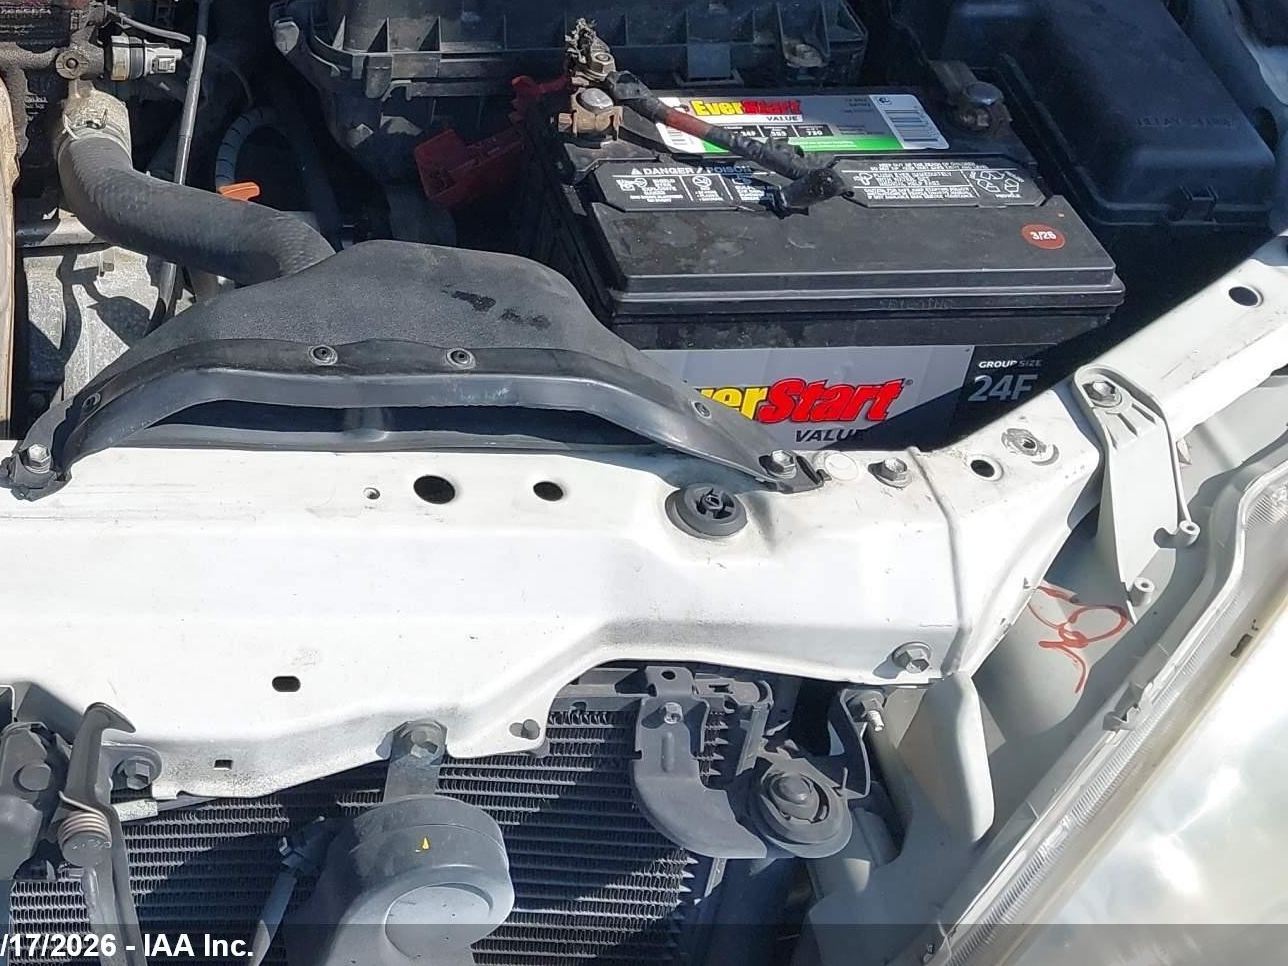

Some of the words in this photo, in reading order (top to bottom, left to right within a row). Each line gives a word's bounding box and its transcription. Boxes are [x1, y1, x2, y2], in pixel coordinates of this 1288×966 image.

[691, 99, 802, 116] EverStart
[642, 167, 695, 175] DANGER
[1030, 231, 1057, 240] 3/26
[978, 360, 1018, 368] GROUP
[1019, 359, 1041, 367] SIZE
[968, 374, 1039, 402] 24F
